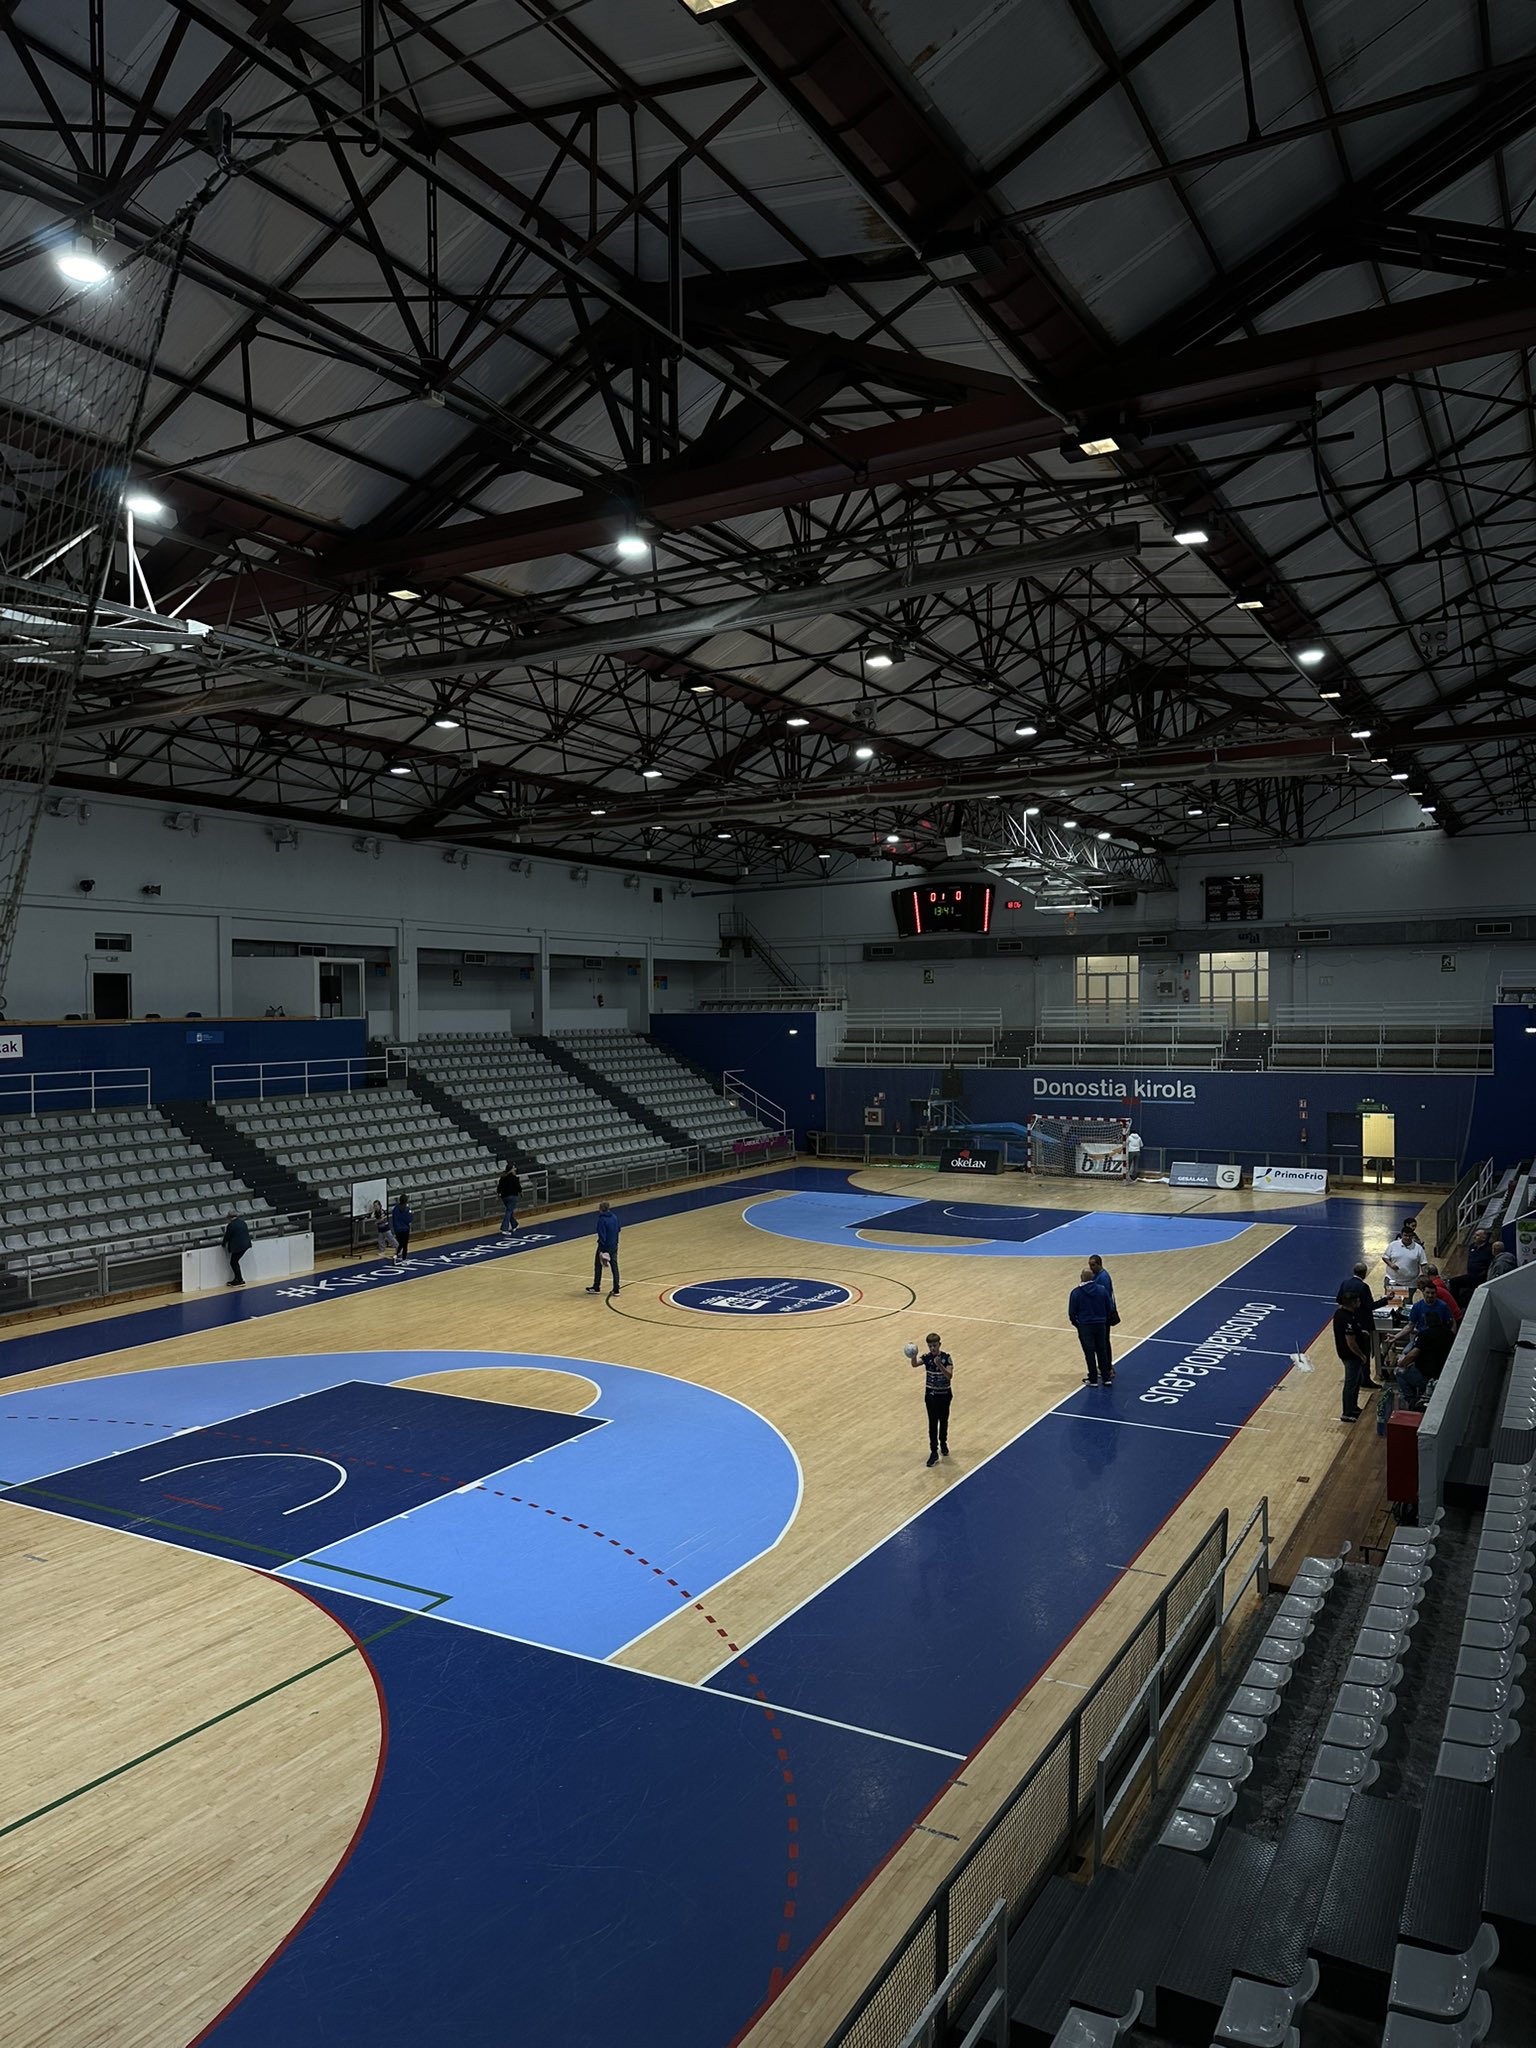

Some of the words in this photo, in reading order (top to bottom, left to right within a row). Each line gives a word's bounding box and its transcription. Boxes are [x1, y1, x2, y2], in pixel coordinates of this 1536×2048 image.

[930, 892, 936, 902] 0
[955, 890, 962, 901] 0
[0, 1041, 17, 1053] ak
[1033, 1077, 1128, 1097] Donostia
[1134, 1079, 1197, 1099] kirola
[1274, 1170, 1324, 1181] PrimaFrio
[1138, 1302, 1285, 1405] donostiakirola.eus
